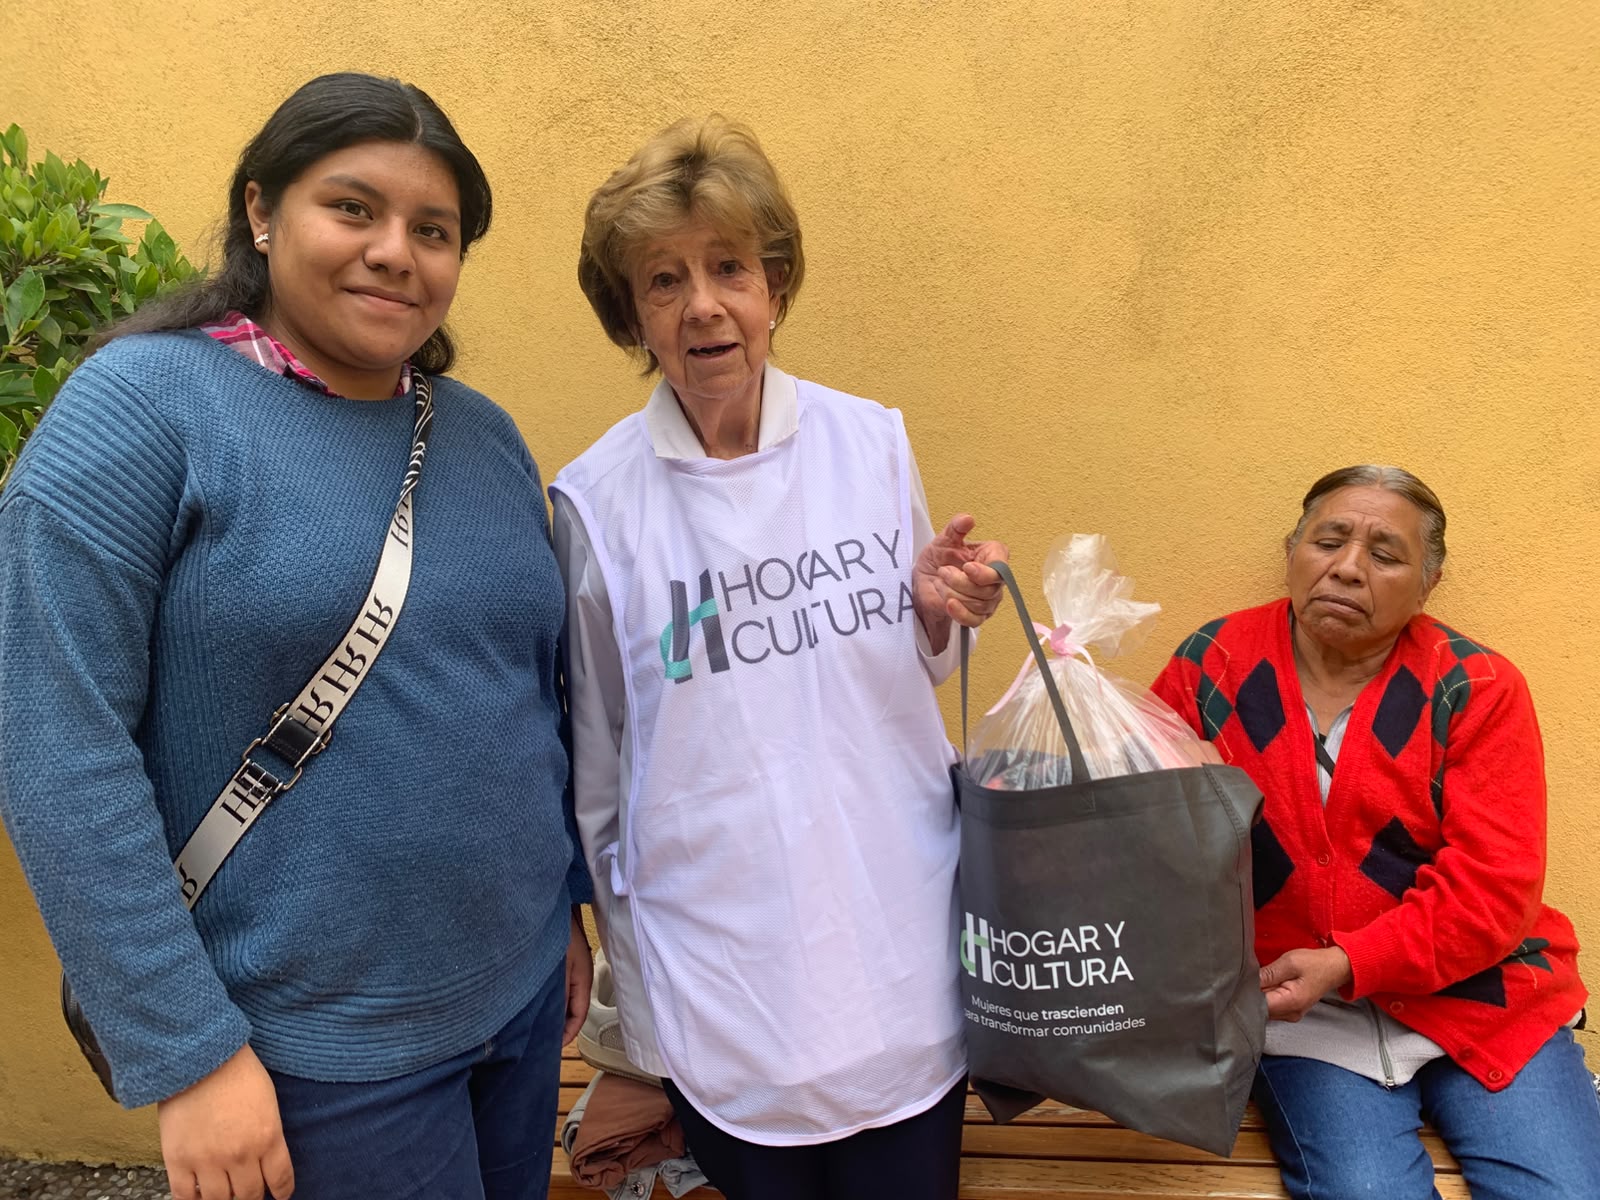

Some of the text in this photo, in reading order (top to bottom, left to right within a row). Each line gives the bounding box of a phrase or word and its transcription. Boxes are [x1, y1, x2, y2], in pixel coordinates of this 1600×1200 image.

[872, 529, 900, 569] Y
[989, 920, 1126, 957] HOGAR Y
[992, 955, 1134, 991] CULTURA
[971, 994, 1124, 1022] Mujeres que trascienden
[980, 1014, 1049, 1038] transformar
[1052, 1016, 1146, 1037] comunidades
